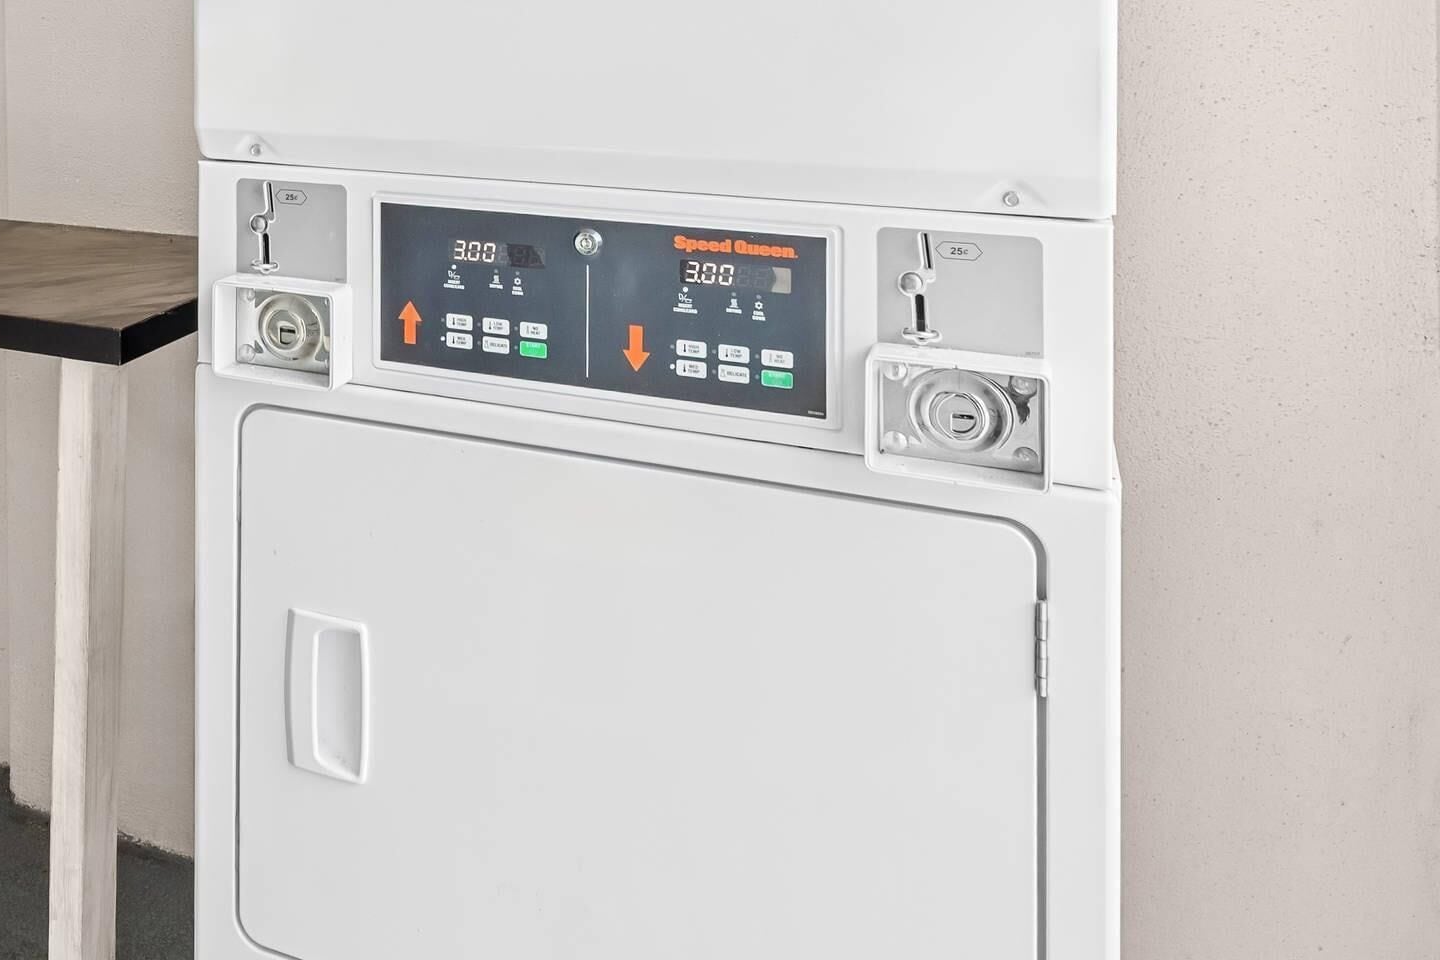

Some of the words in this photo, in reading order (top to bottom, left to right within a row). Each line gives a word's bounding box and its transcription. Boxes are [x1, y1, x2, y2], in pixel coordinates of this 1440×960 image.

[454, 240, 496, 263] 3.00
[673, 235, 732, 253] Speed
[685, 261, 735, 286] 3.00
